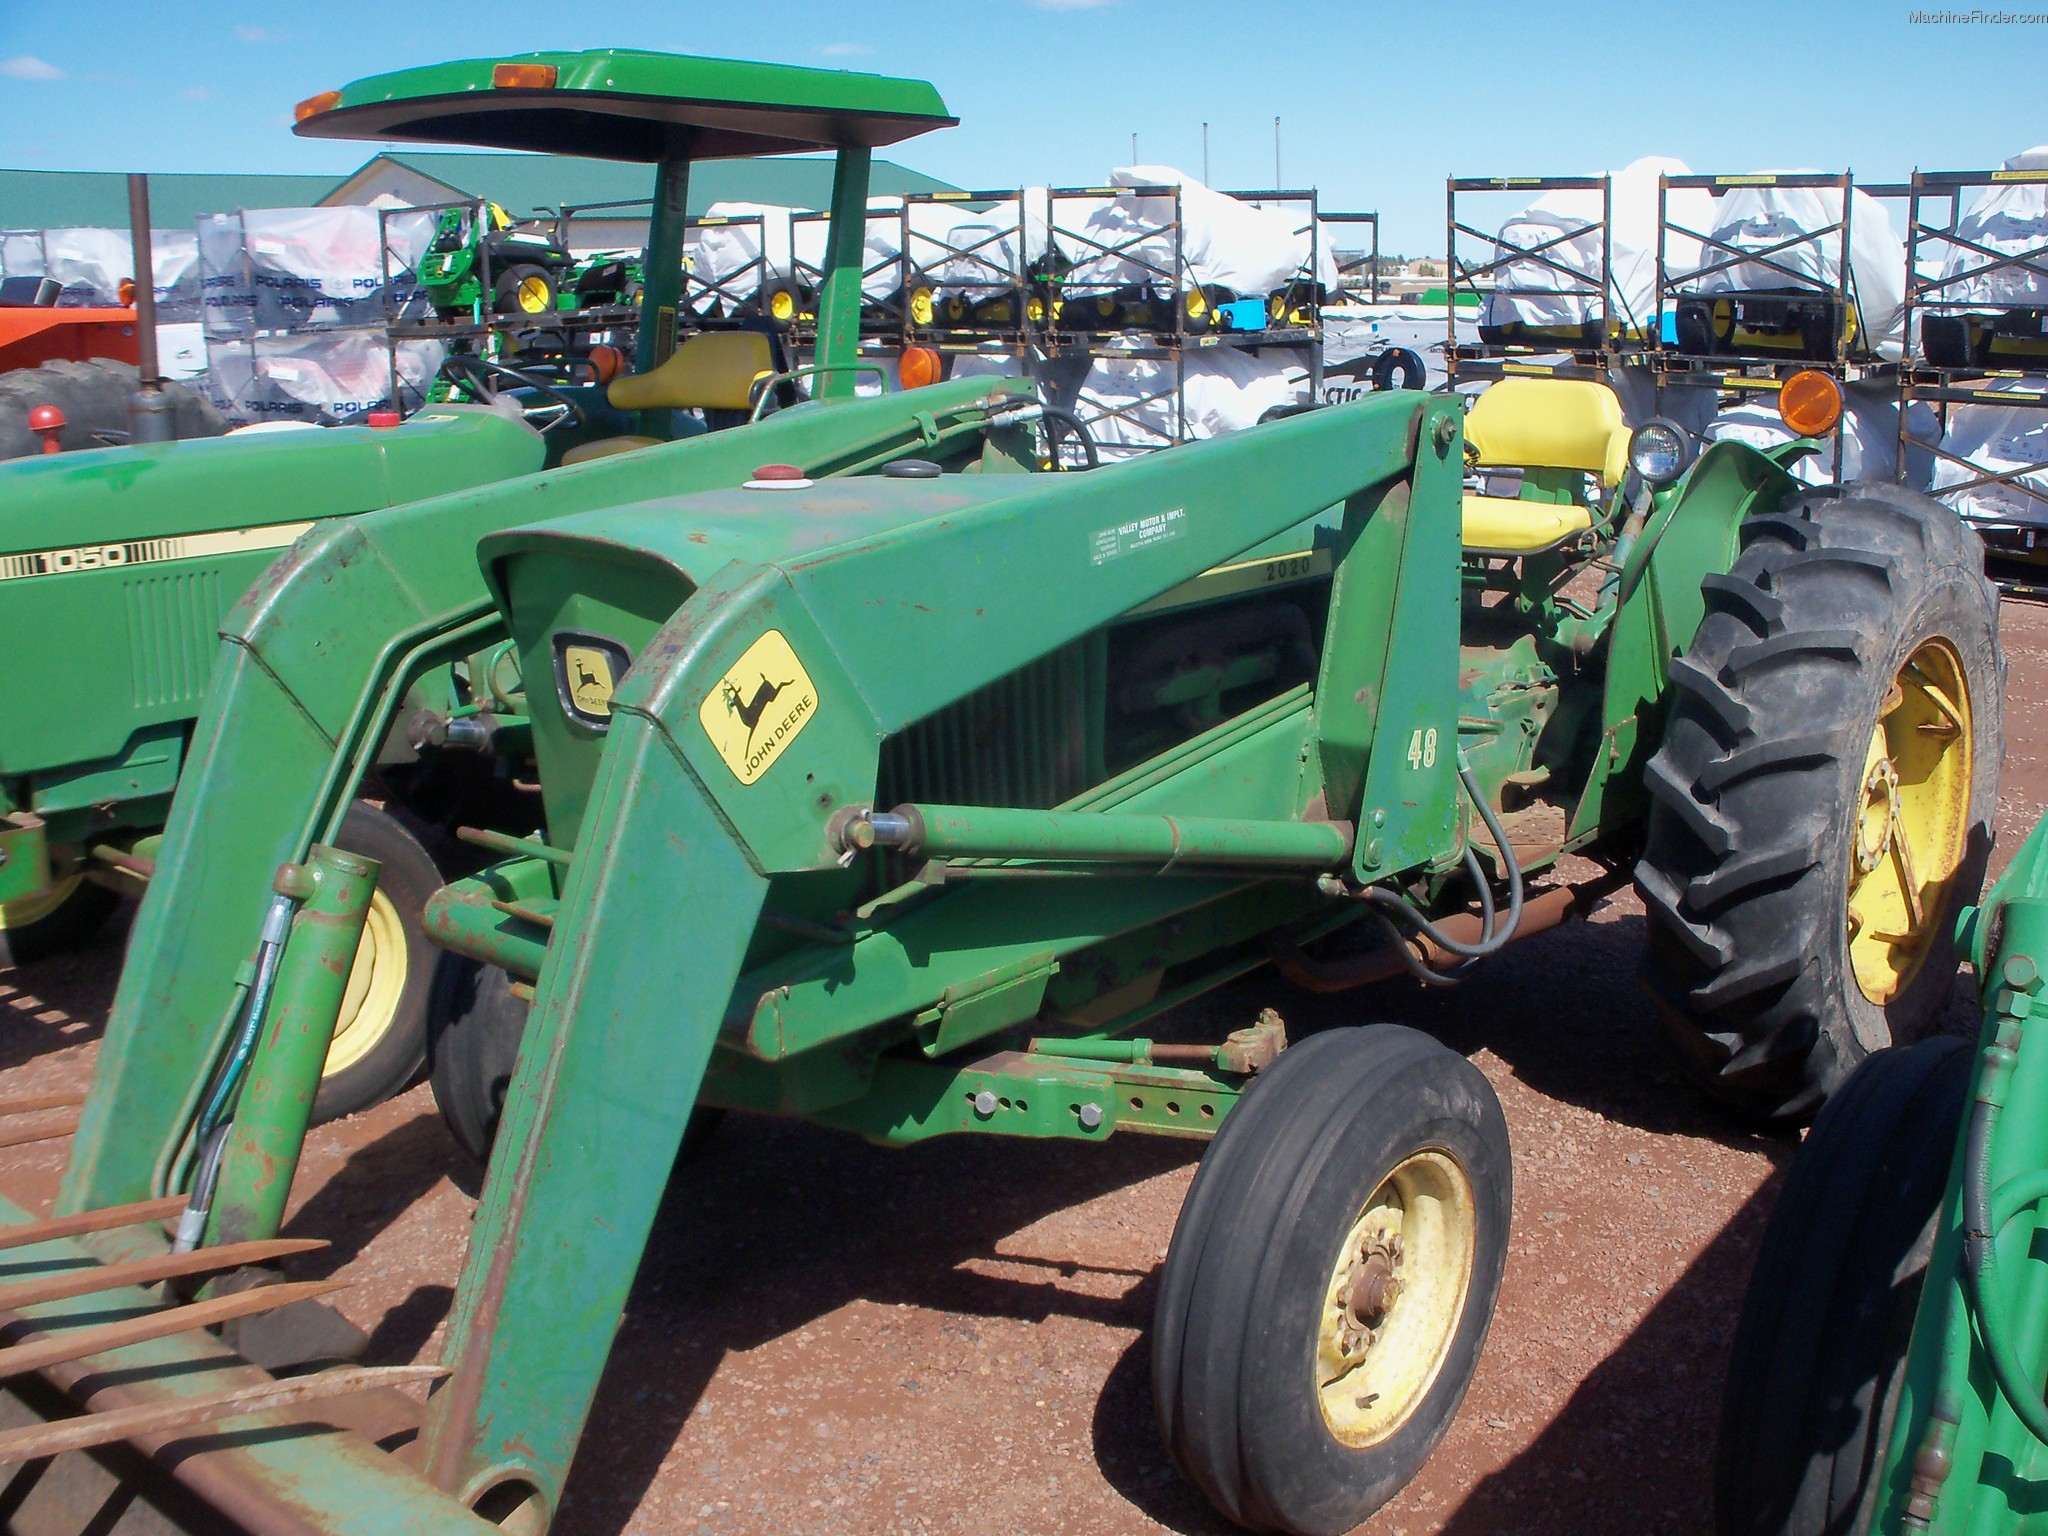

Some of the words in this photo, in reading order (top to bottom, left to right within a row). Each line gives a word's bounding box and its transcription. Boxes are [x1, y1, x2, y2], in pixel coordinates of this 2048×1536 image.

[255, 275, 322, 289] POLARIS
[1118, 521, 1139, 536] VALLEY
[1139, 515, 1160, 529] MOTOR
[1138, 523, 1167, 539] COMPANY
[40, 545, 127, 573] 1050
[1266, 557, 1310, 581] 2020
[745, 739, 776, 777] JOHN
[776, 694, 813, 741] DEERE
[1407, 728, 1437, 770] 48
